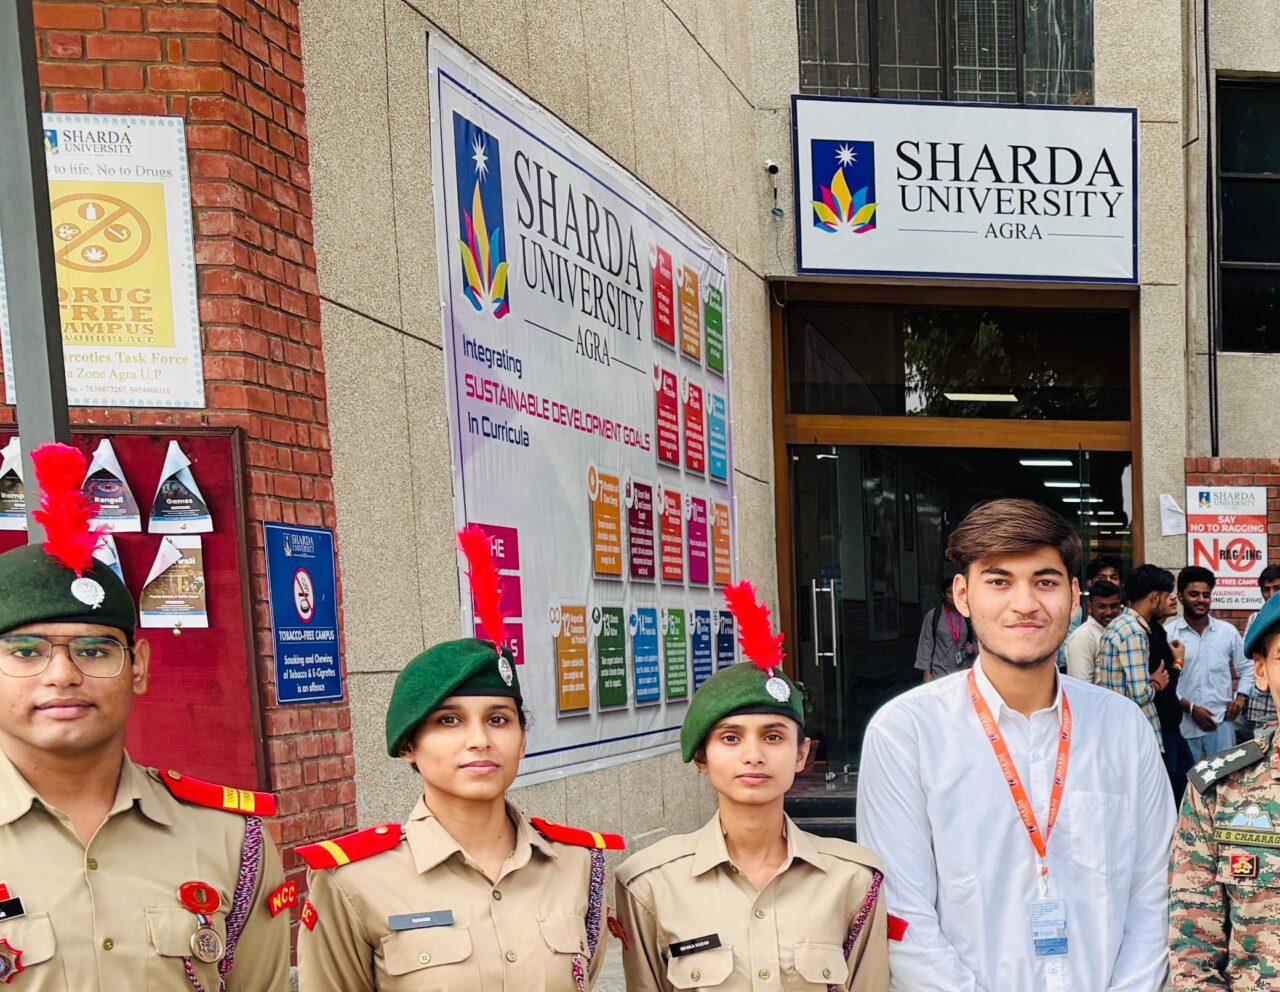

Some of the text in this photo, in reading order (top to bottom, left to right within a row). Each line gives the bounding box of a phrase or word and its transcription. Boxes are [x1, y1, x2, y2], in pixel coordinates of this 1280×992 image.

[63, 130, 132, 144] SHARDA
[65, 143, 132, 154] UNIVERSITY
[54, 164, 66, 175] to
[70, 163, 94, 176] life,
[98, 164, 116, 176] No
[119, 166, 131, 176] to
[136, 167, 173, 178] Drugs
[896, 140, 1124, 187] SHARDA
[898, 185, 1123, 218] UNIVERSITY
[514, 150, 644, 293] SHARDA
[984, 222, 1043, 240] AGRA
[520, 233, 644, 341] UNIVERSITY
[63, 322, 154, 335] AMPUS
[575, 325, 611, 367] AGRA
[115, 352, 147, 364] Task
[152, 352, 189, 365] Force
[463, 334, 522, 379] Integrating
[76, 368, 105, 379] Zone
[109, 369, 137, 382] Agra
[465, 373, 550, 420] SUSTAINABLE
[551, 401, 622, 442] DEVELOPMENT
[623, 425, 651, 451] GOALS
[468, 411, 530, 447] In Curricula
[94, 496, 124, 505] Rangoli
[1213, 492, 1256, 501] SHARDA
[1218, 515, 1237, 524] SAY
[1190, 524, 1265, 533] NO TO RAGGING
[291, 534, 315, 546] SHARDA
[292, 545, 315, 553] UNIVERSITY
[490, 537, 505, 558] HE
[1193, 537, 1258, 573] NO
[1219, 549, 1263, 561] RAGING
[1222, 578, 1240, 586] FREE
[1241, 597, 1263, 605] CRIME
[278, 629, 335, 641] TOBACCO-FREE CAMPUS
[284, 653, 334, 667] Smoking and Chewing
[283, 669, 289, 680] of
[289, 669, 308, 679] Tobacco
[297, 683, 302, 694] is
[302, 684, 309, 693] an
[273, 886, 295, 912] NCC
